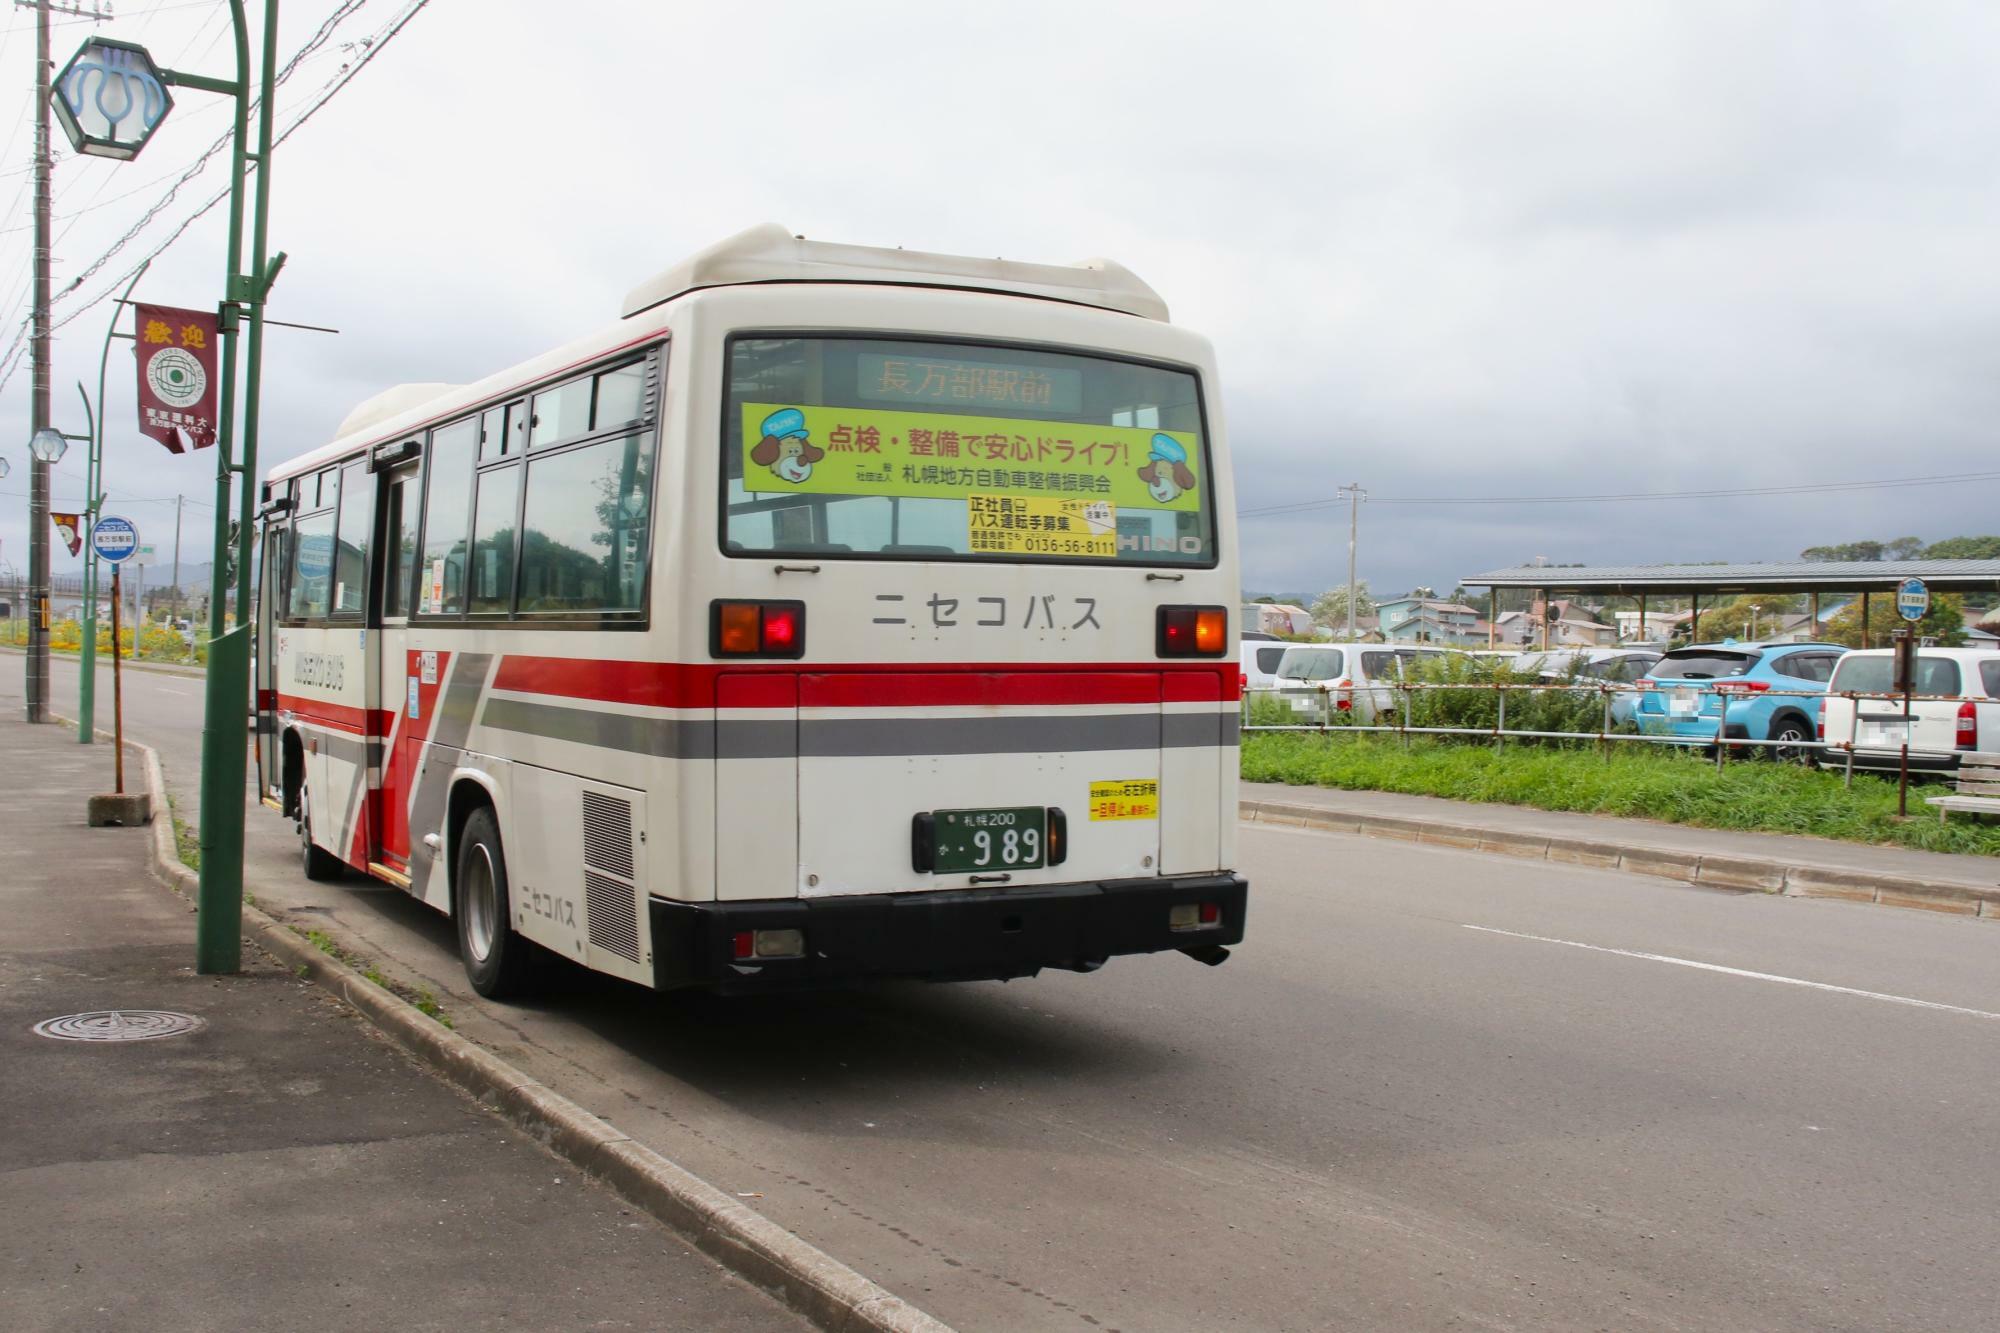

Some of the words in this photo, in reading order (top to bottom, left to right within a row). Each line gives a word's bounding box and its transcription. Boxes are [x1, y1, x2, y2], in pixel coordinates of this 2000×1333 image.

[878, 360, 1052, 404] 長万部駅前
[827, 423, 1130, 467] 点検・整備で安心ドライブ!
[902, 464, 1111, 494] 札幌地方自動車整備振興会
[970, 496, 1014, 514] 正社員
[970, 513, 1071, 531] バス運転手募集
[1025, 538, 1115, 554] 0136-56-8111
[1117, 534, 1202, 554] HINO
[872, 592, 1101, 630] ニセコバス
[522, 885, 577, 929] ニセコバス
